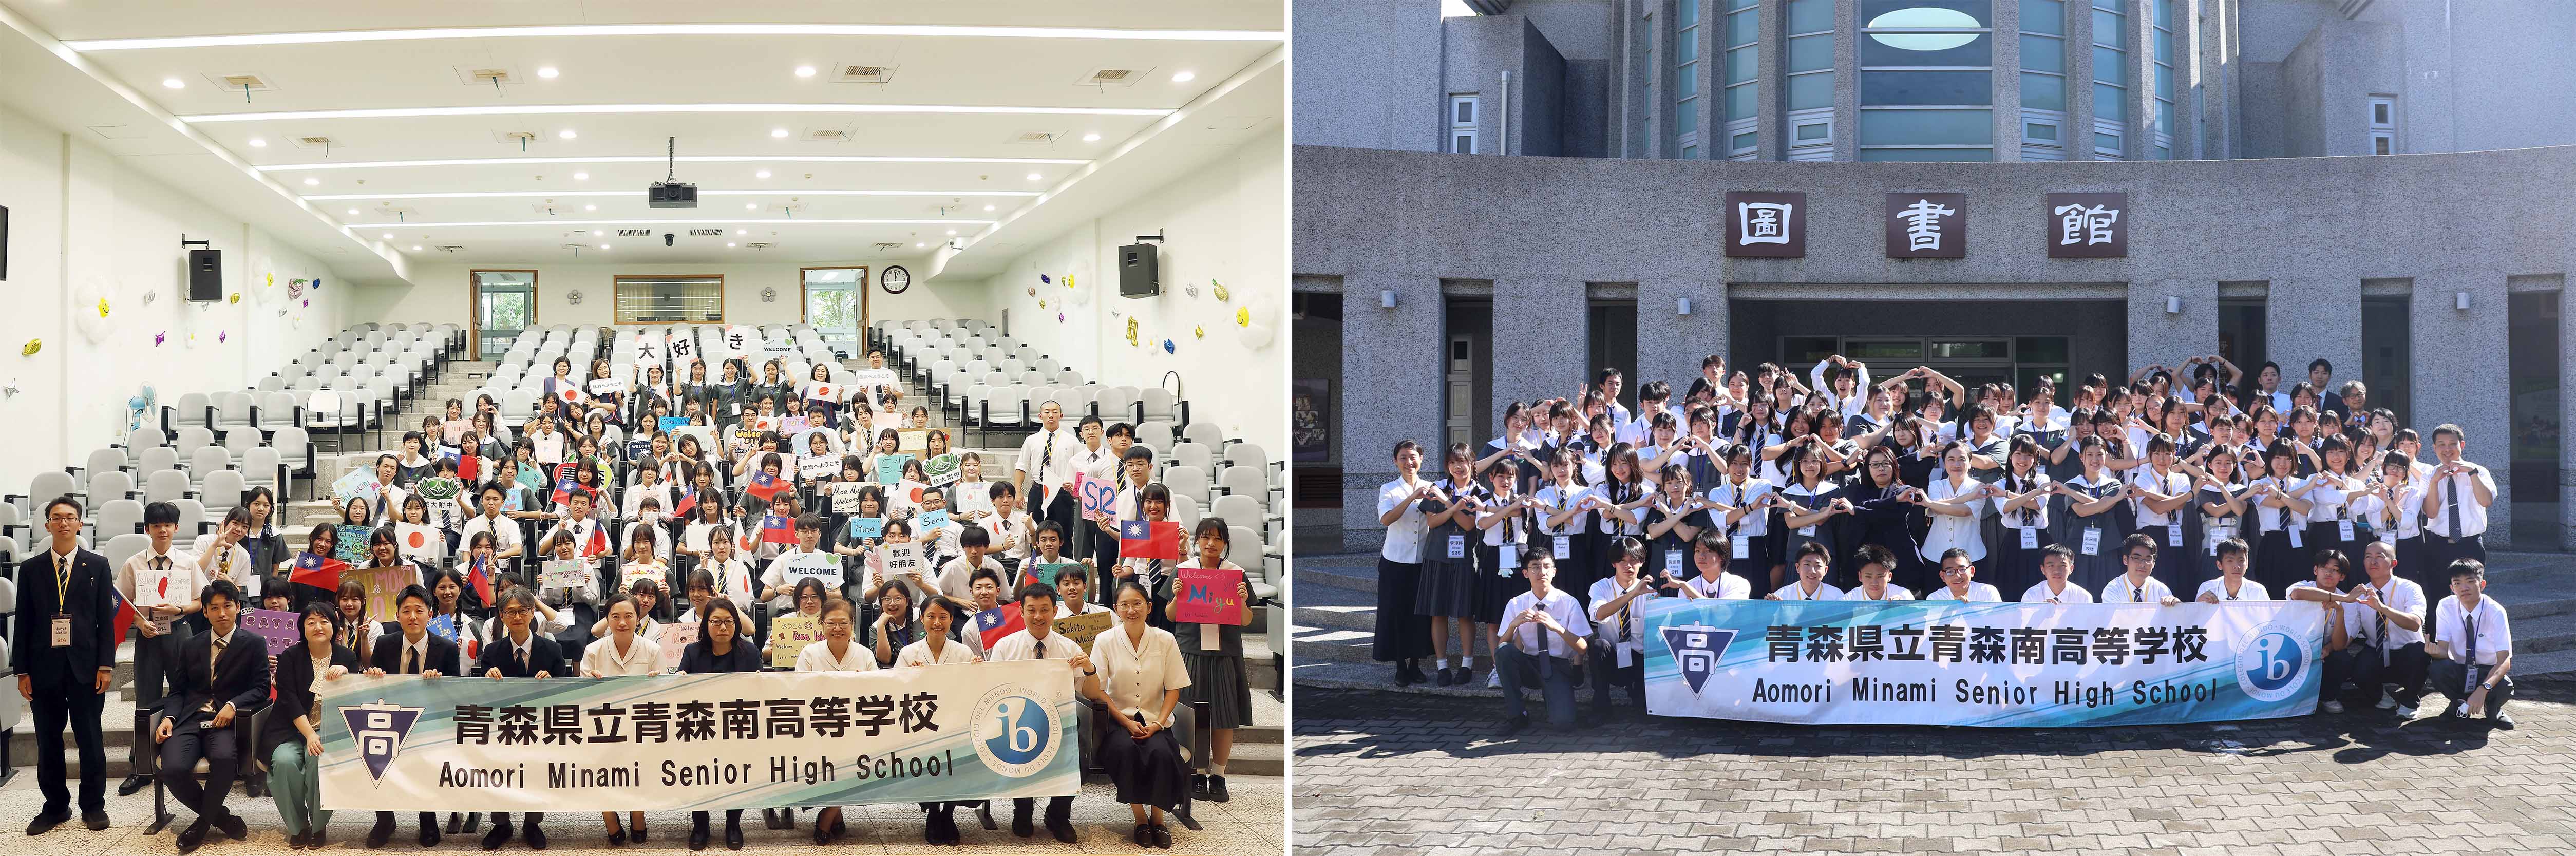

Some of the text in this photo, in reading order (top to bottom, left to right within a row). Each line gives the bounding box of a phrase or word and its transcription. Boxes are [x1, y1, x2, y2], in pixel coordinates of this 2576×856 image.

[1739, 199, 2119, 251] 圖 書 館
[672, 339, 690, 358] 好
[729, 334, 743, 350] き
[638, 343, 655, 359] 大
[856, 524, 875, 533] Hina
[922, 516, 944, 526] Sera
[893, 548, 910, 558] 歡迎
[789, 567, 837, 576] WELCOME
[889, 559, 916, 569] 好朋友
[1181, 570, 1213, 580] Welcome
[1187, 584, 1235, 614] Miyu
[792, 631, 810, 641] Risa
[1058, 622, 1085, 634] Sakito
[2279, 624, 2301, 640] WORLD
[1765, 624, 2207, 664] 青森県立青森南高等学校
[2239, 640, 2248, 653] DEL
[1752, 678, 2217, 708] Aomori Minami Senior High School
[453, 692, 939, 745] 青森県立青森南高等学校
[1019, 687, 1059, 736] WORLD SCHOOL
[974, 687, 1011, 757] COLEGIO DEL MUNDO
[440, 749, 952, 788] Aomori Minami Senior High School
[991, 759, 1021, 774] MONDE
